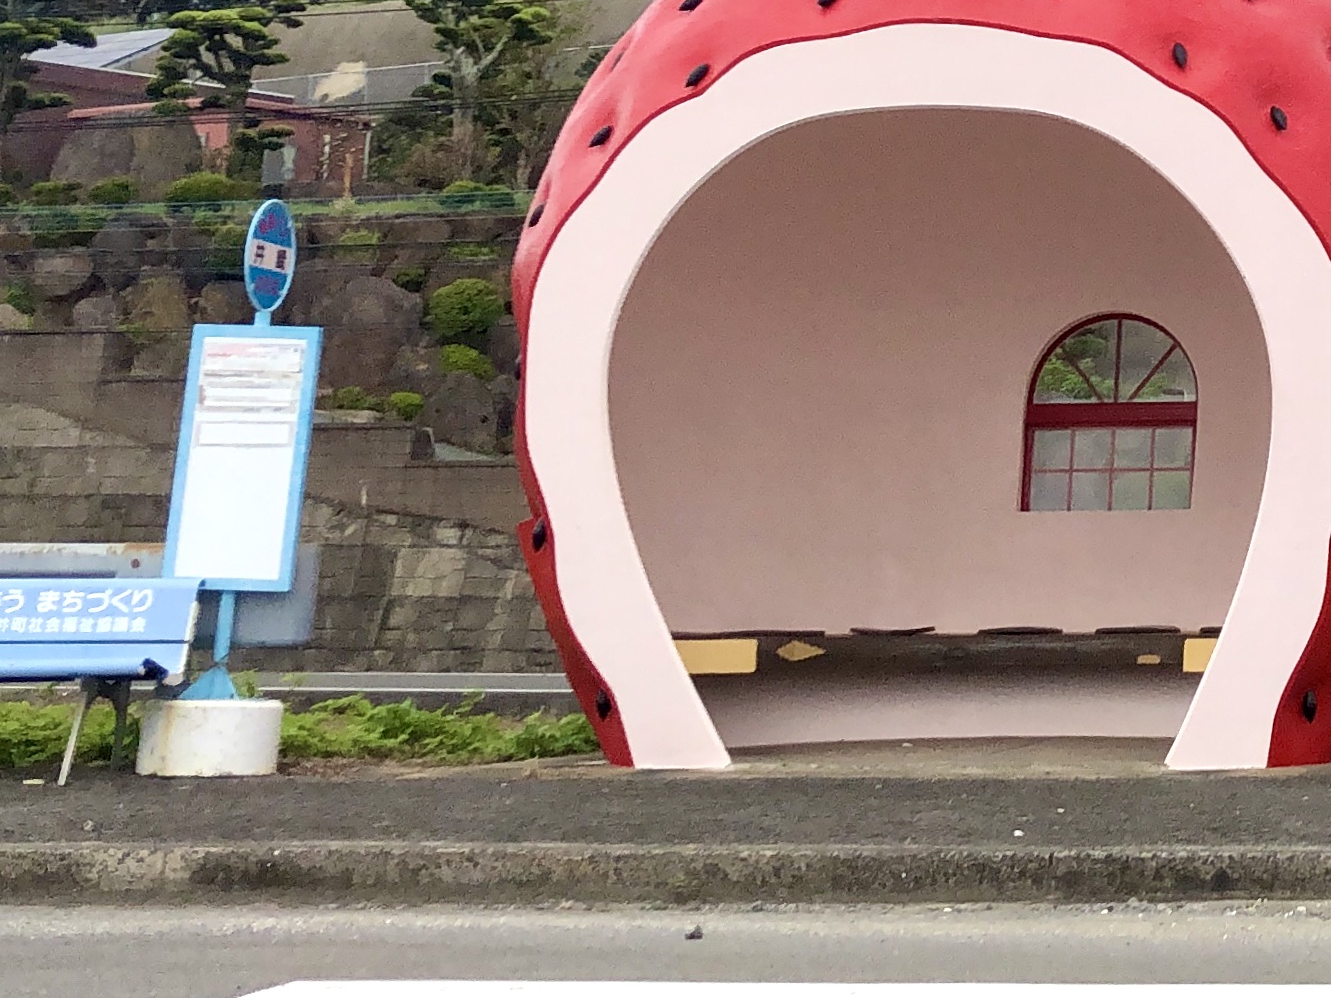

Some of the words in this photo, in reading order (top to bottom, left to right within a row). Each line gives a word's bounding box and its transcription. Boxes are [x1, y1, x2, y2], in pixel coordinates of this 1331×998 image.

[0, 589, 25, 613] う
[37, 589, 152, 613] まちづくり
